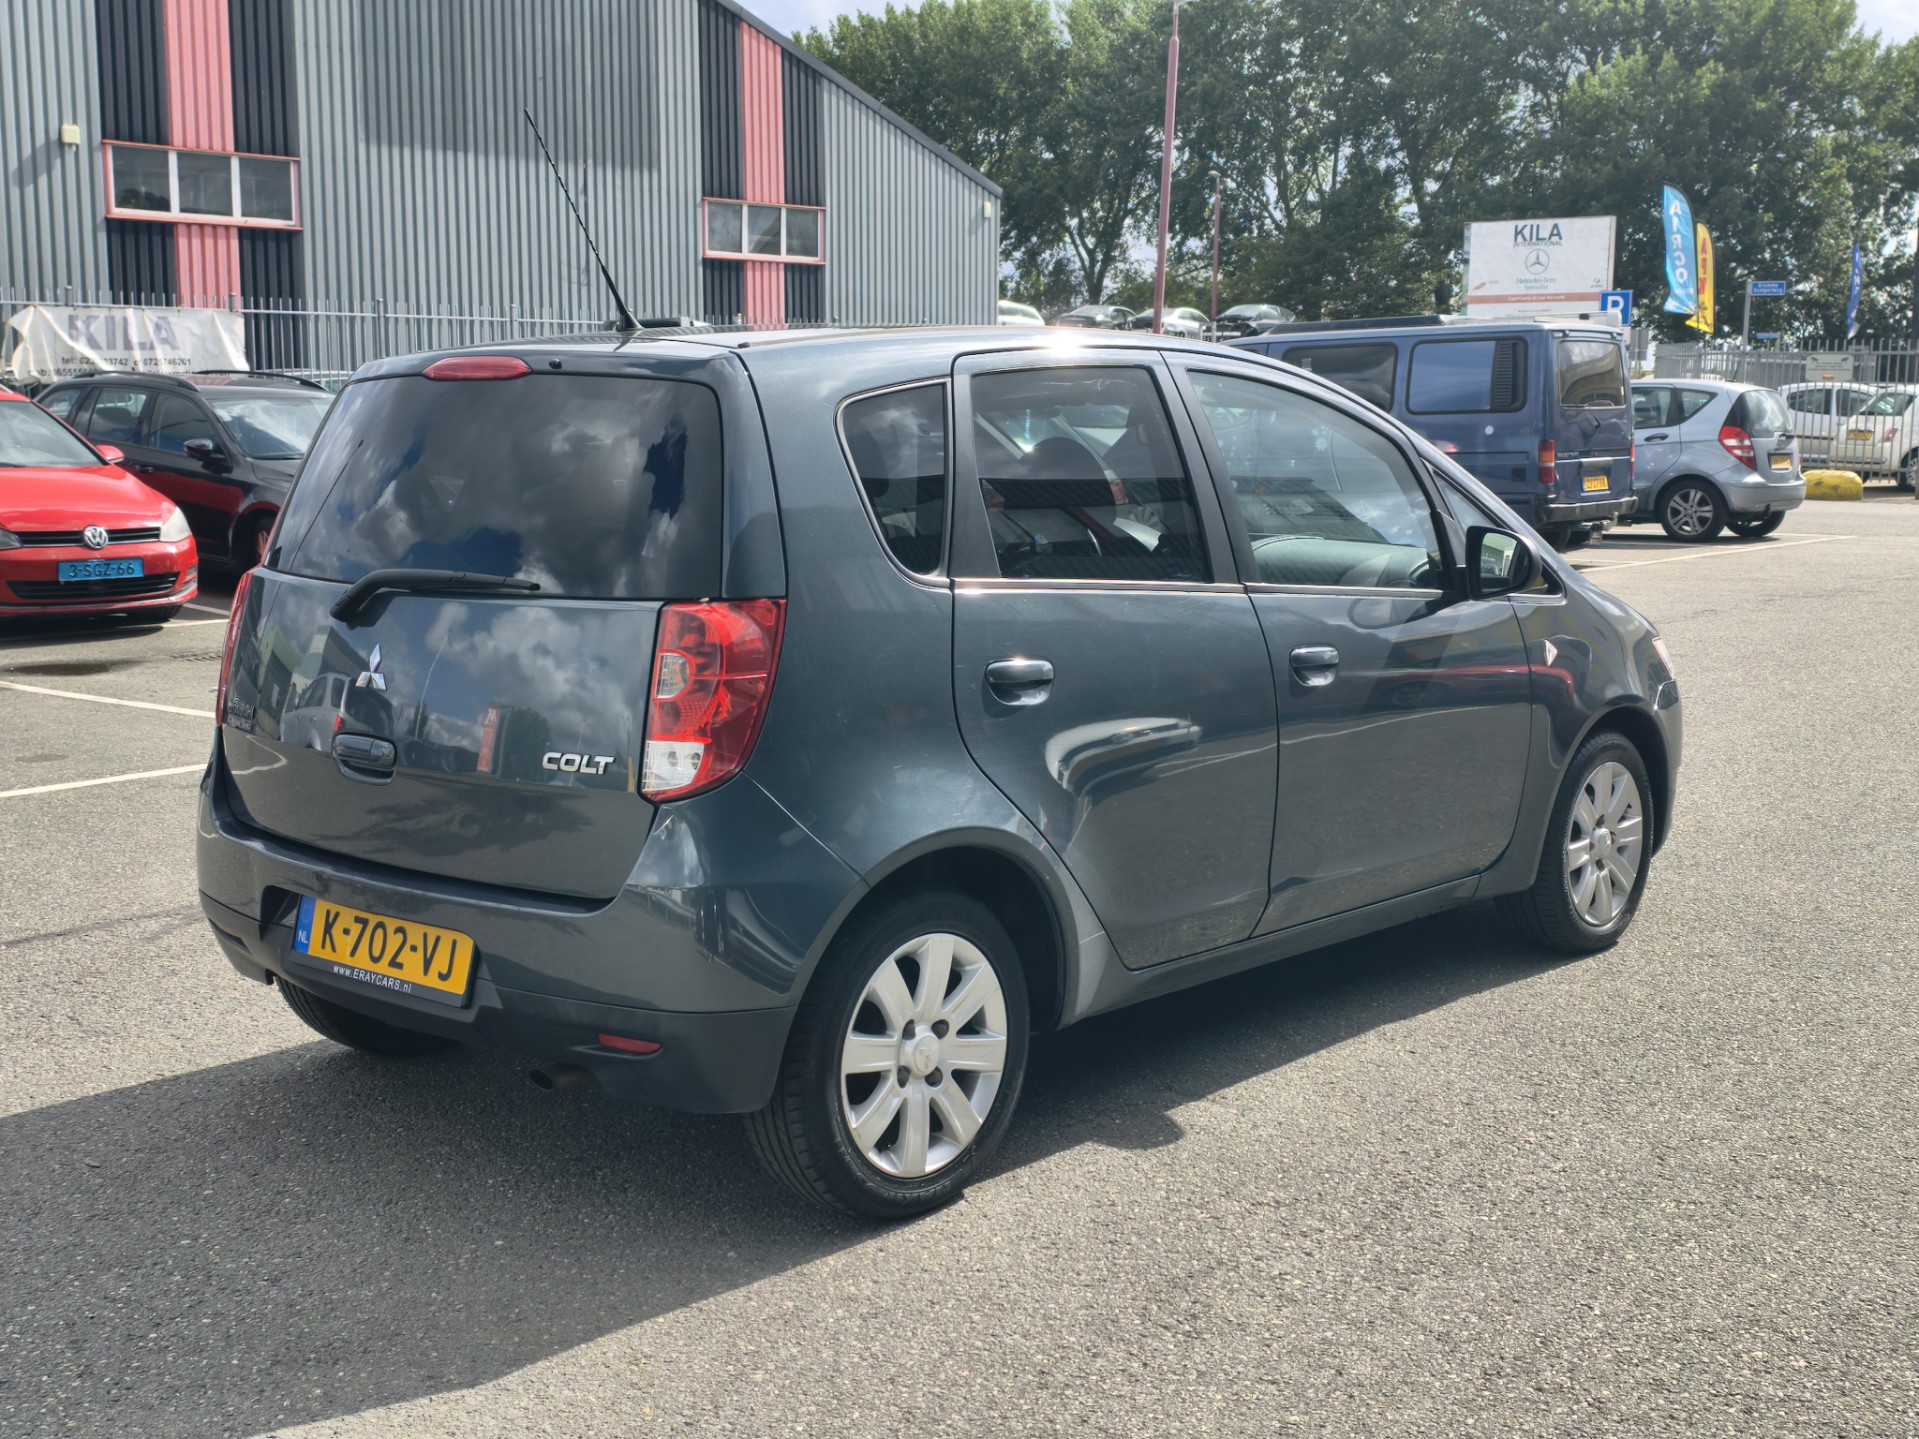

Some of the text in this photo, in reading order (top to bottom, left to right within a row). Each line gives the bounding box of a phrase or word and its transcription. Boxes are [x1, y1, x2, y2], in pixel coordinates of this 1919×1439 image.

[1514, 223, 1562, 242] KILA
[68, 315, 180, 350] KILA
[61, 356, 77, 365] tel:
[143, 358, 192, 367] 072746201
[69, 561, 136, 579] 3-SGZ-66
[541, 752, 616, 775] COLT
[297, 929, 309, 944] NL
[320, 909, 458, 983] K-702-VJ
[333, 964, 413, 995] www.ERAYCARS.nl
